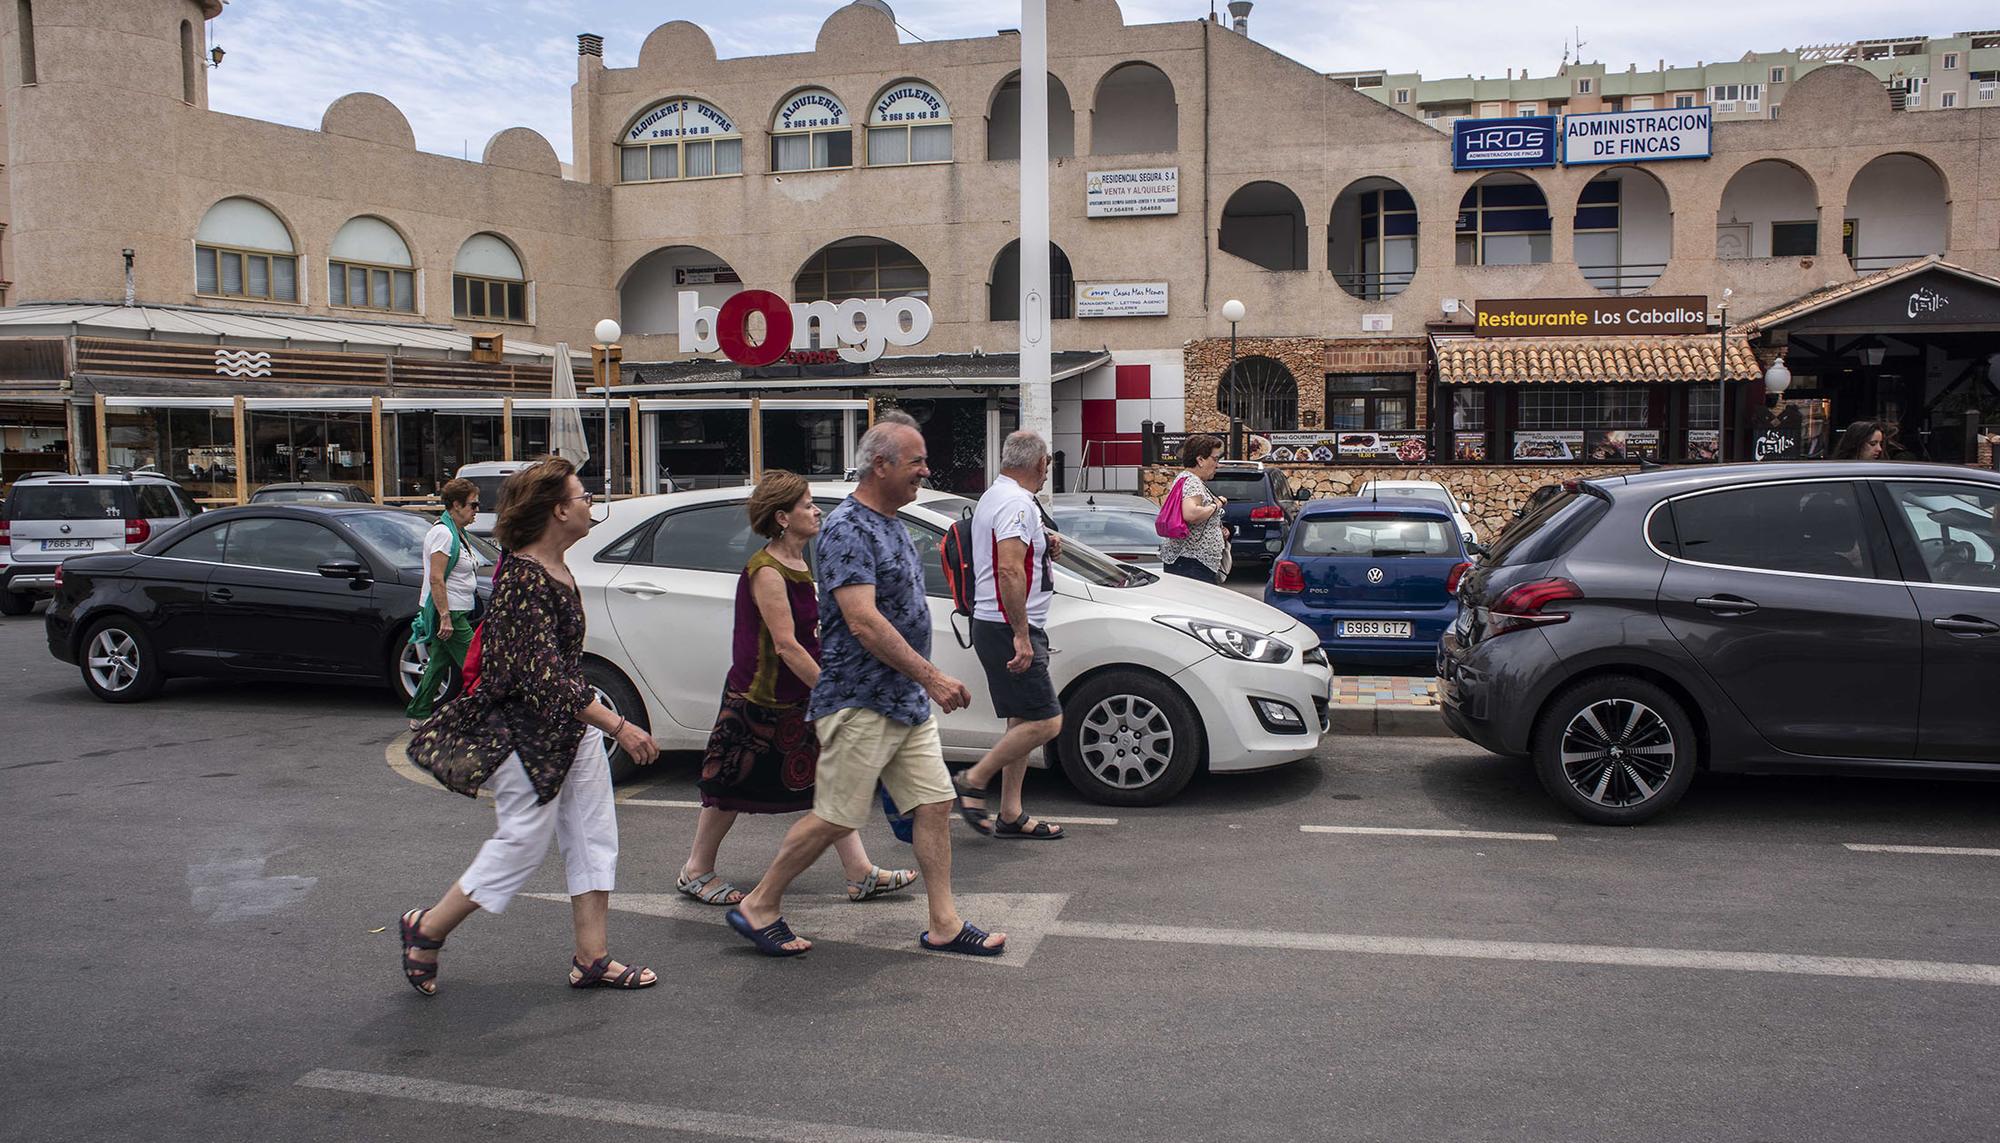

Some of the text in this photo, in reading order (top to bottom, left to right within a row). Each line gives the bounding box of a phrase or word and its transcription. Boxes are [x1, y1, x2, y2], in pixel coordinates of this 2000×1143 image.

[782, 95, 843, 120] ALQUILERES
[878, 88, 941, 114] ALQUILERES
[631, 101, 732, 139] ALQUILERES VENTAS
[1568, 114, 1707, 137] ADMINISTRACION
[1466, 131, 1544, 149] HROS
[1594, 136, 1680, 155] DE FINCAS
[1101, 173, 1138, 183] RESIDENCIAL
[1104, 187, 1126, 195] VENTA
[1131, 287, 1144, 296] Mar
[1478, 308, 1704, 327] Restaurante Los Caballos
[785, 350, 839, 365] COPAS
[74, 539, 92, 548] JFX
[1347, 622, 1407, 634] 6969 GTZ
